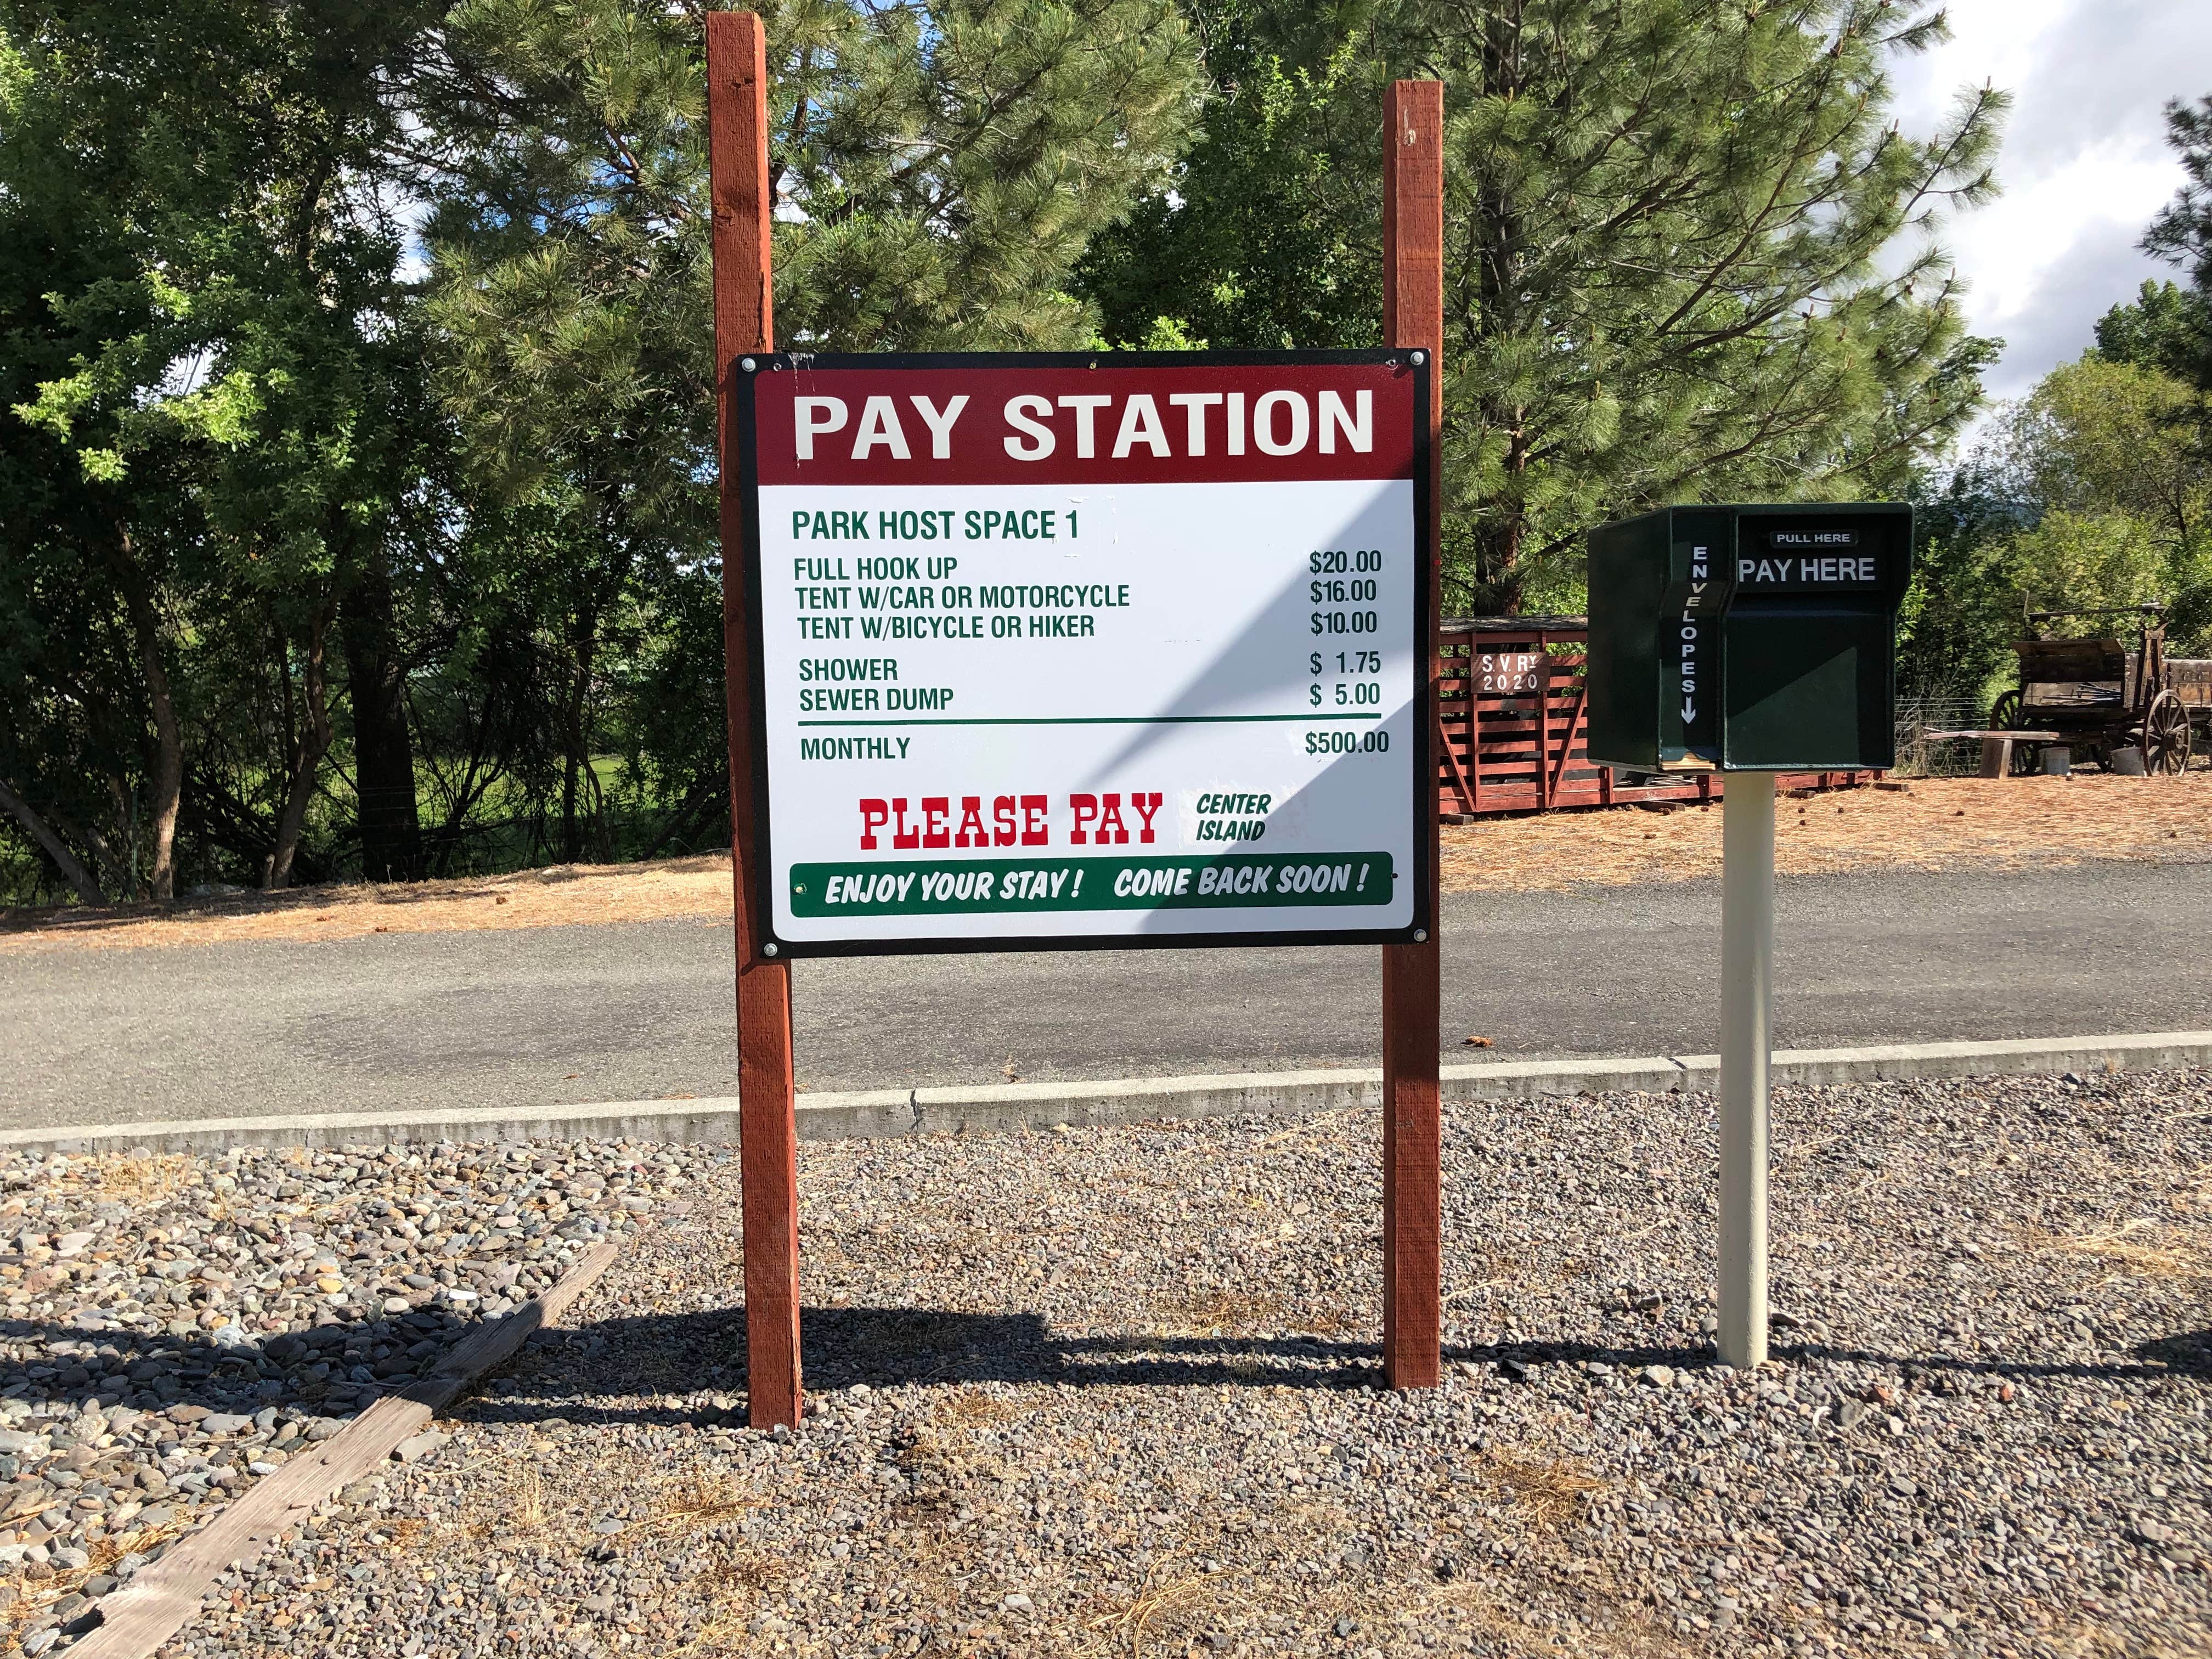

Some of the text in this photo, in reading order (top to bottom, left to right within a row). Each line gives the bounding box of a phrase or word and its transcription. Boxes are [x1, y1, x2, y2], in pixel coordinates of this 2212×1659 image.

[794, 390, 1372, 461] PAY STATION
[793, 510, 1077, 540] PARK HOST SPACE 1
[1777, 534, 1850, 543] PULL HERE
[794, 557, 957, 580] FULL HOOK UP
[1310, 550, 1381, 575] $20.00
[1739, 558, 1876, 582] PAY HERE
[795, 585, 1130, 611] TENT W/CAR OR MOTORCYCLE
[1311, 579, 1376, 605] $16.00
[797, 616, 1094, 641] TENT W/BICYCLE OR HIKER
[1311, 611, 1376, 636] $10.00
[1680, 546, 1707, 692] ENVELOPES
[799, 659, 898, 681] SHOWER
[800, 689, 953, 711] SEWER DUMP
[802, 737, 910, 760] MONTHLY
[1306, 731, 1389, 756] $500.00
[1197, 793, 1271, 814] CENTER
[860, 793, 1163, 850] PLEASE PAY
[1197, 821, 1265, 842] ISLAND
[825, 872, 916, 904] ENJOY
[922, 872, 994, 901] YOUR
[1114, 868, 1192, 896] COME
[1198, 865, 1273, 895] BACK
